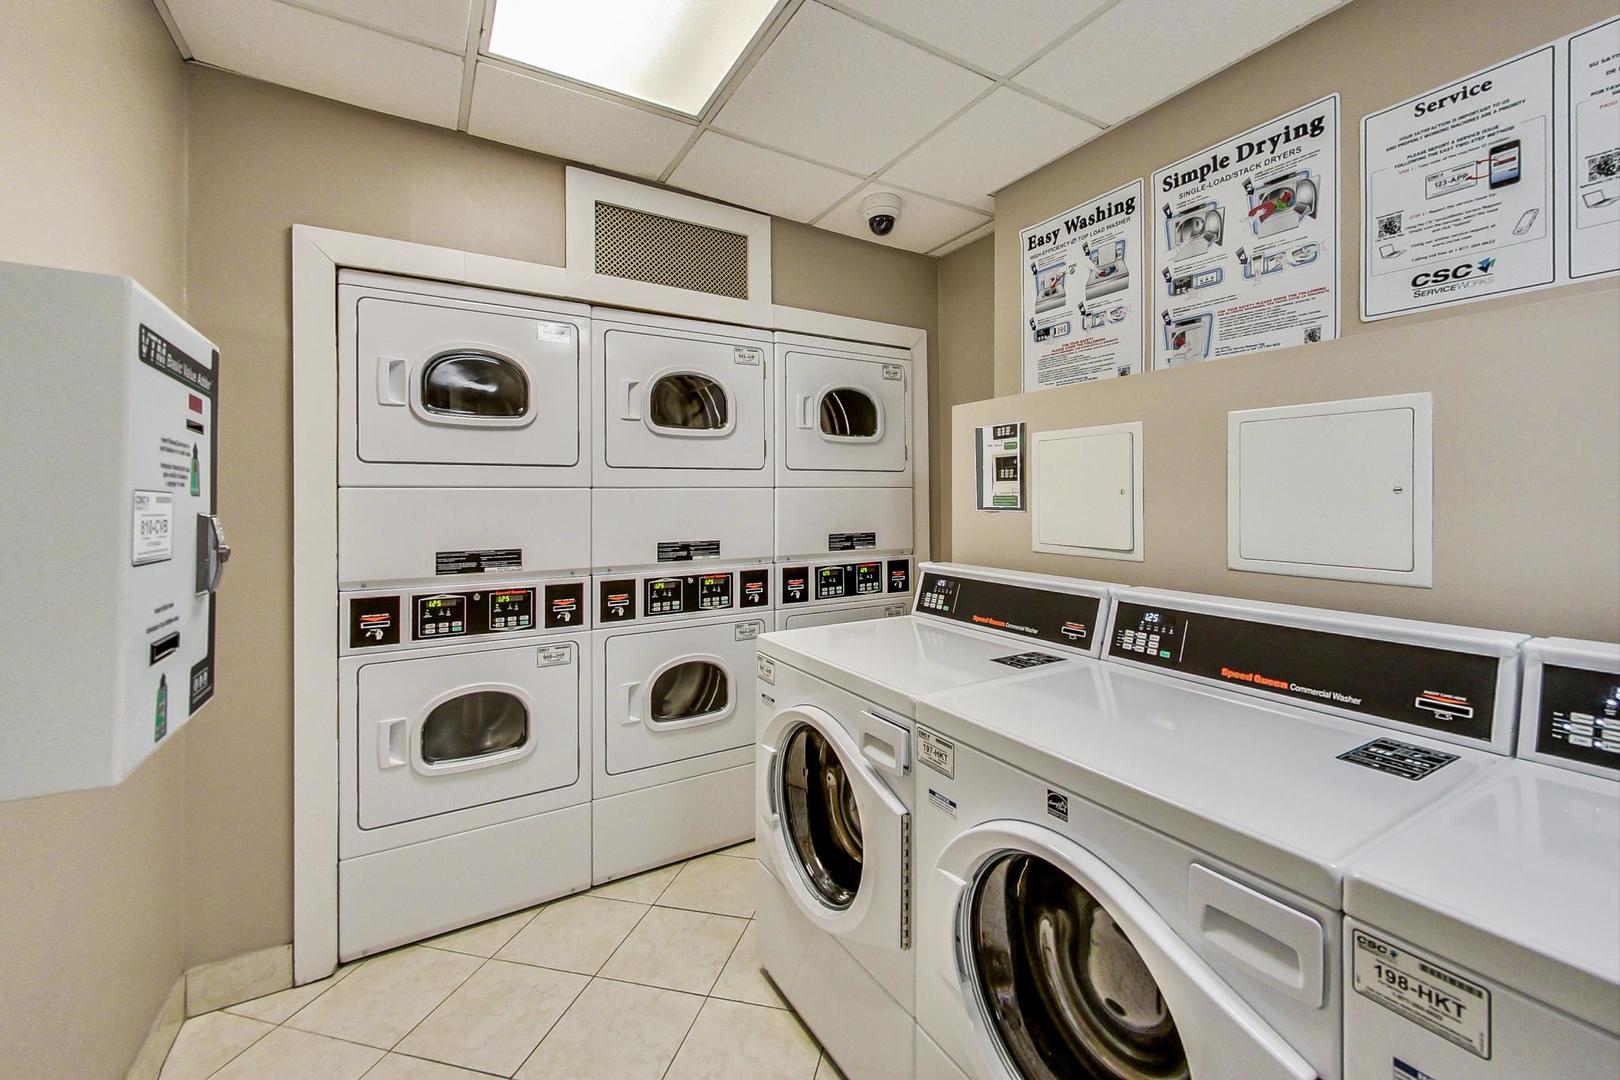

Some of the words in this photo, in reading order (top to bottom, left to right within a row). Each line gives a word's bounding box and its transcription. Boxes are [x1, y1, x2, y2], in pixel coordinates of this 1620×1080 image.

[1414, 79, 1493, 118] Service
[1162, 153, 1231, 193] Simple
[1236, 115, 1325, 163] Drying
[1178, 161, 1262, 200] SINGLE-LOAD/STACK
[1264, 146, 1303, 167] DRYERS
[1027, 228, 1061, 251] Easy
[1064, 196, 1136, 235] Washing
[1090, 227, 1105, 237] LOAD
[1411, 263, 1473, 288] CSC
[1221, 667, 1253, 681] Speed
[1254, 674, 1289, 690] Queen
[1290, 683, 1332, 699] Commercial
[1332, 692, 1362, 705] Washer
[923, 744, 948, 762] 197-HKT
[1357, 935, 1388, 955] CSC
[1374, 964, 1467, 1018] 198-HKT
